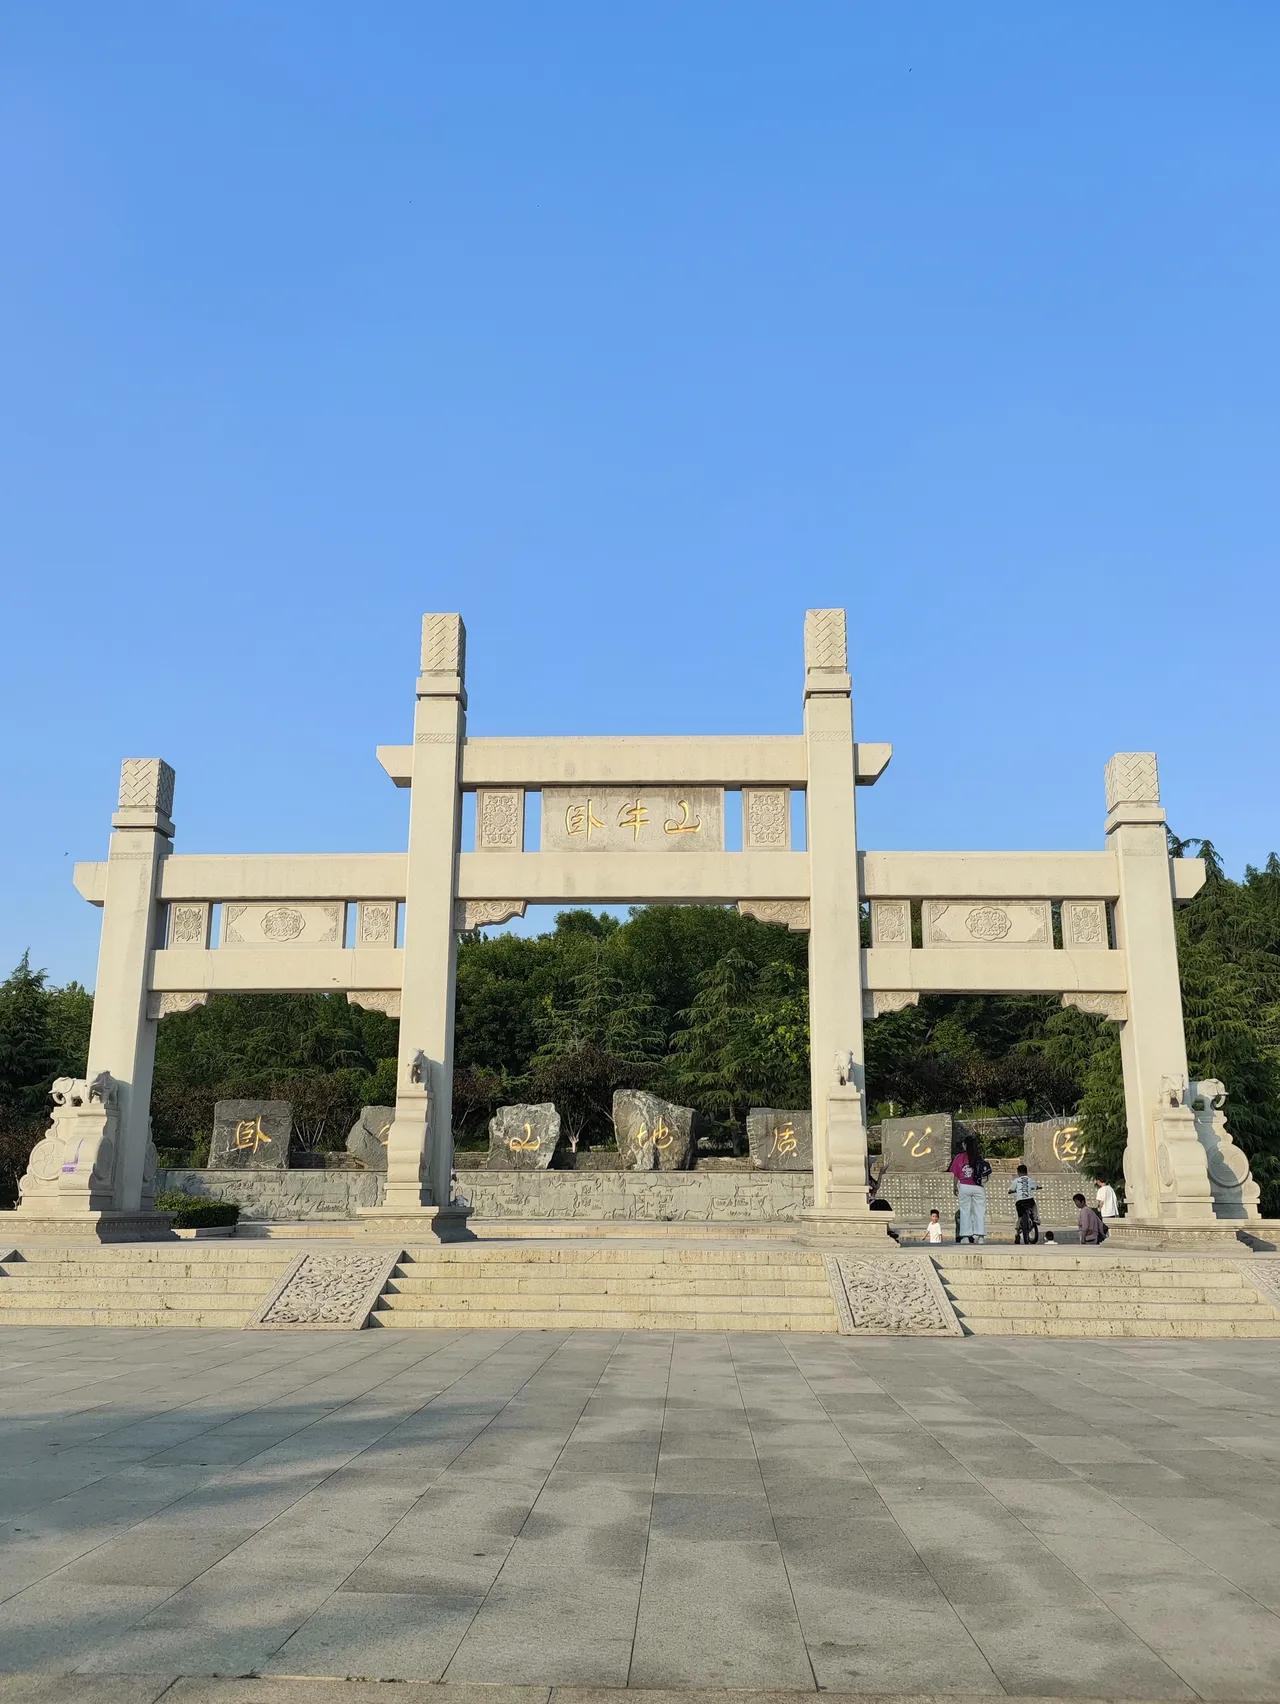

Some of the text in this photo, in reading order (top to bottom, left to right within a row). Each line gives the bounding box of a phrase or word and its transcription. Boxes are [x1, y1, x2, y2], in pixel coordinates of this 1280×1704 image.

[565, 798, 702, 842] 卧牛山
[235, 1115, 272, 1153] 卧
[509, 1123, 541, 1151] 山
[636, 1116, 674, 1150] 地
[769, 1121, 798, 1157] 质
[902, 1126, 933, 1157] 公
